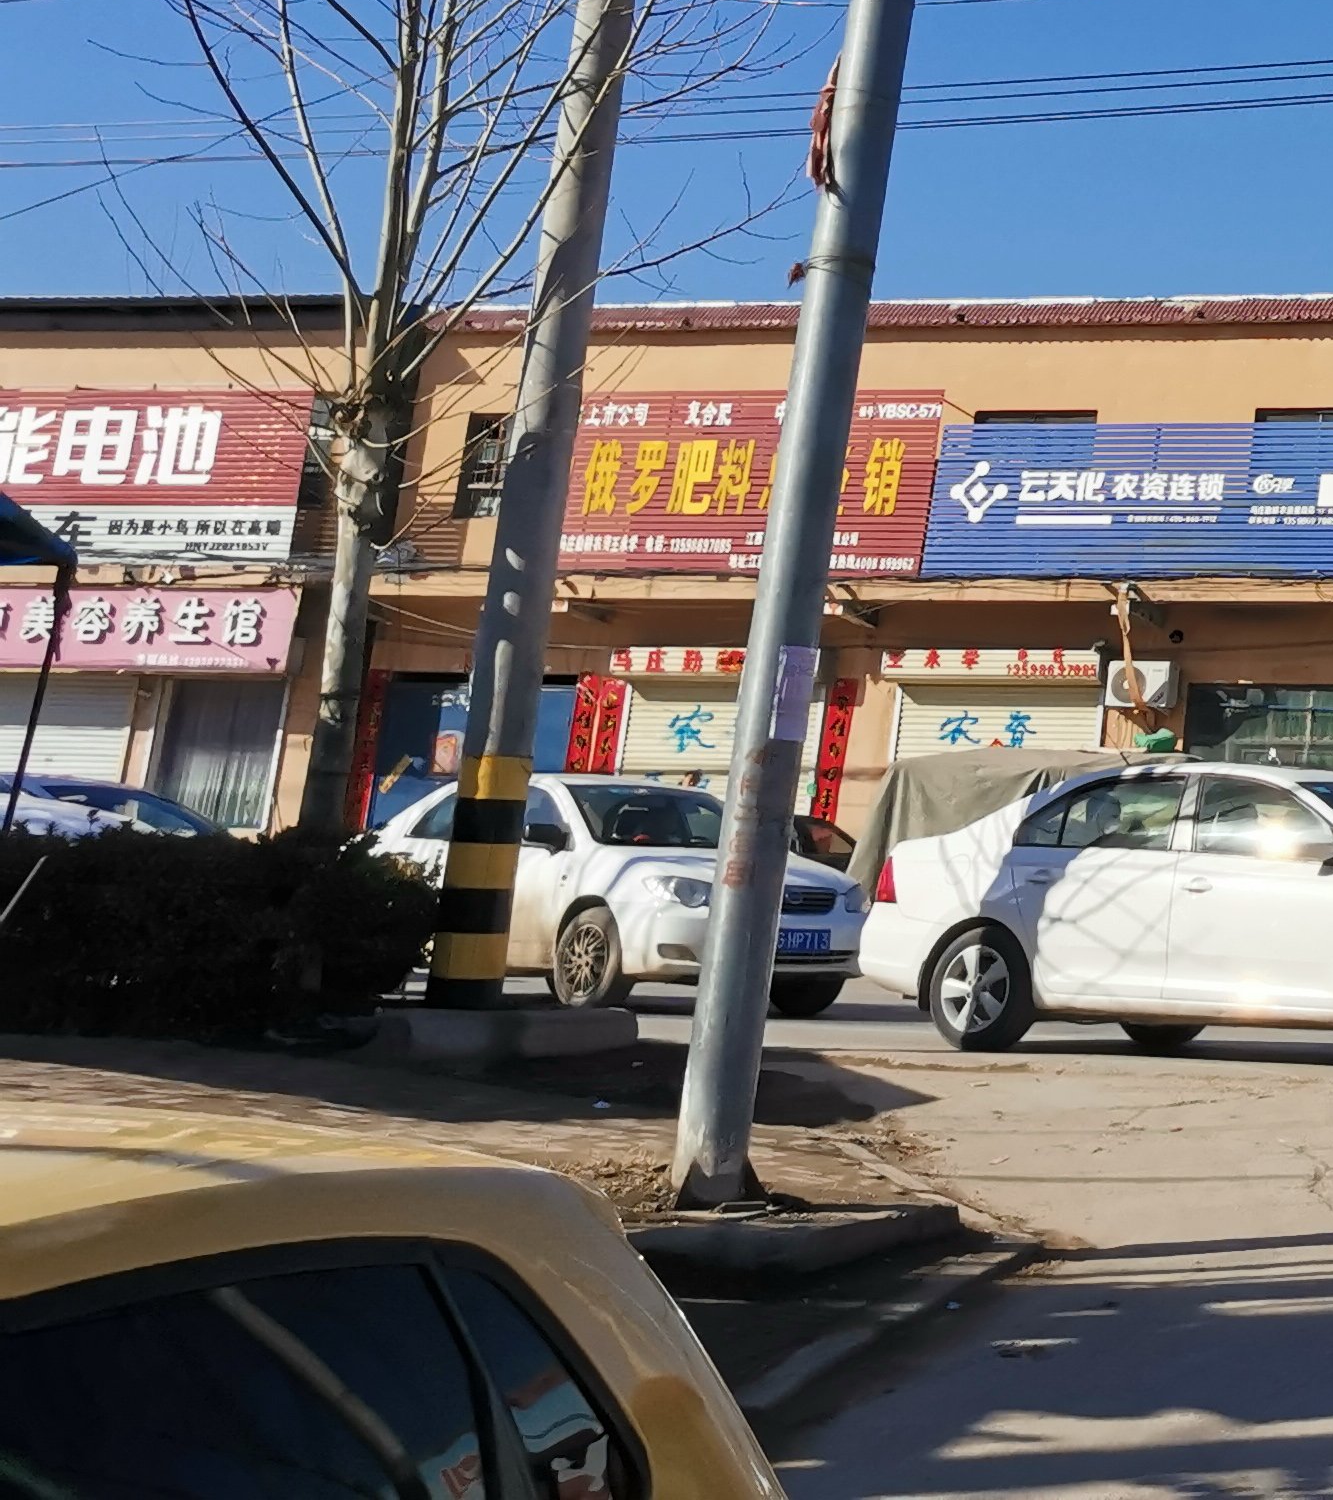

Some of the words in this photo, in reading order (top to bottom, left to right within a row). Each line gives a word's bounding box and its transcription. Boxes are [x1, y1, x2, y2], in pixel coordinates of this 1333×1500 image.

[578, 402, 650, 427] 上市公司
[0, 405, 222, 485] 能电池
[1018, 470, 1105, 502] 云天化
[1111, 472, 1225, 501] 农资连锁
